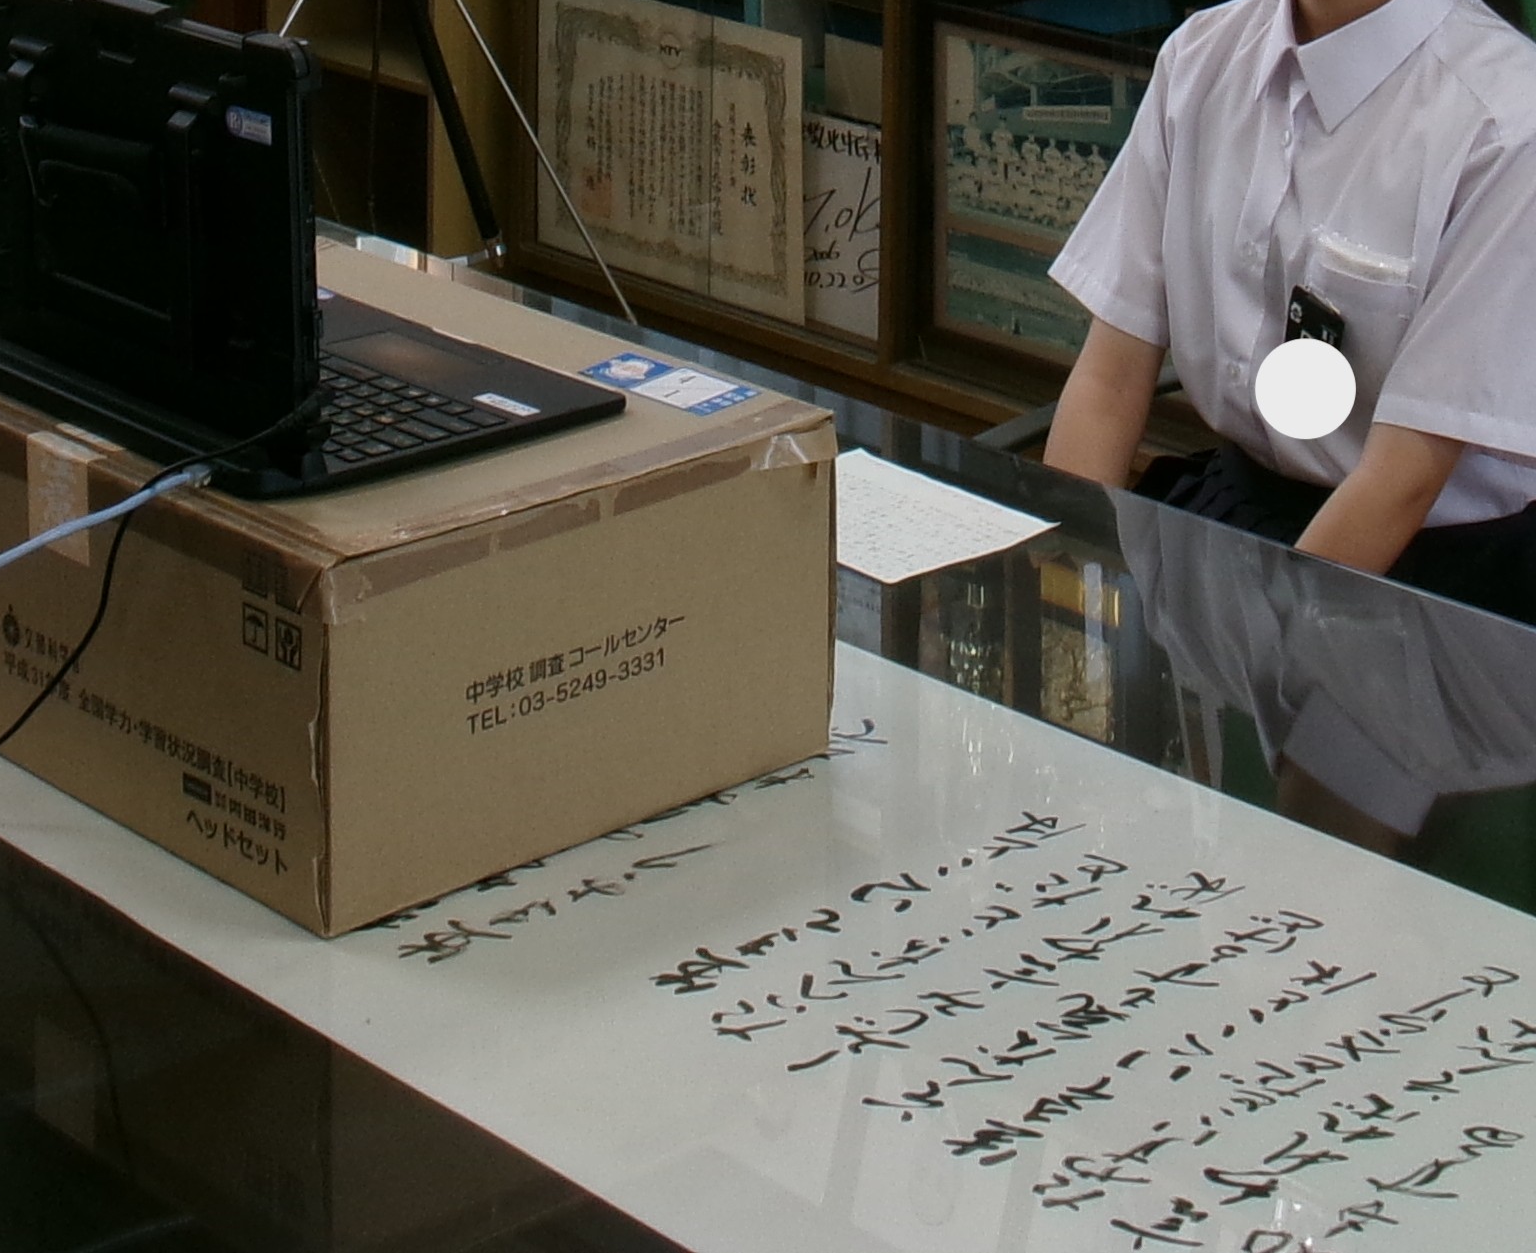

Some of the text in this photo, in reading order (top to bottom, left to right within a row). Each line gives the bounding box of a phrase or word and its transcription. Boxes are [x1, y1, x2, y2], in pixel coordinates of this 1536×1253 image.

[466, 615, 686, 705] 中学校 調査 コールセンター
[187, 810, 288, 875] ヘッドセット
